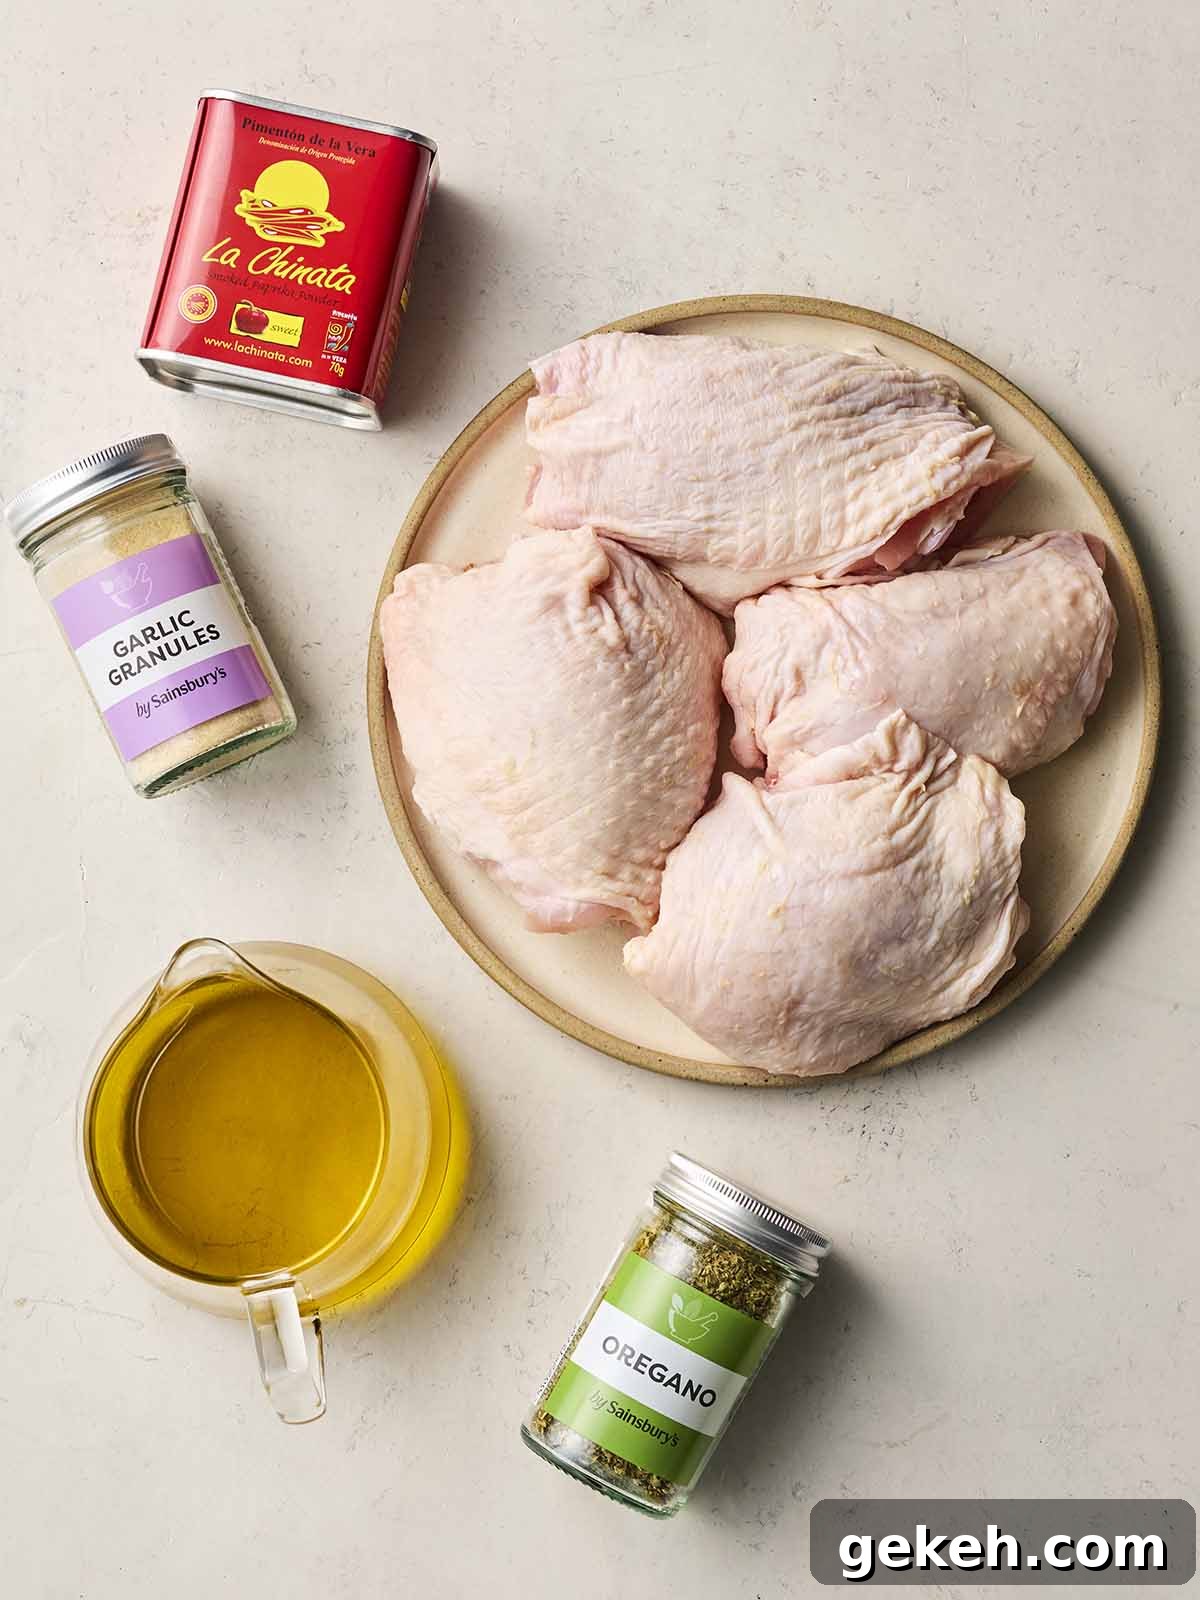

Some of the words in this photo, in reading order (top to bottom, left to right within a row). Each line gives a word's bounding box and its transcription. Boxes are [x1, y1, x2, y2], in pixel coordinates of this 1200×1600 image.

[241, 117, 305, 142] Pimentón
[309, 133, 325, 147] de
[328, 137, 341, 152] la
[345, 140, 376, 158] Vera
[299, 146, 308, 154] de
[307, 147, 328, 159] Origen
[201, 237, 241, 268] La
[247, 245, 357, 295] Chinata
[203, 336, 313, 368] www.lachinata.com
[270, 325, 299, 336] sweet
[329, 361, 345, 377] 70g
[332, 355, 347, 364] VERA
[108, 623, 221, 687] GRANULES
[112, 609, 196, 659] GARLIC
[135, 702, 152, 718] by
[151, 667, 227, 707] Sainsbury's
[602, 1335, 717, 1409] OREGANO
[606, 1401, 681, 1447] Sainsbury's
